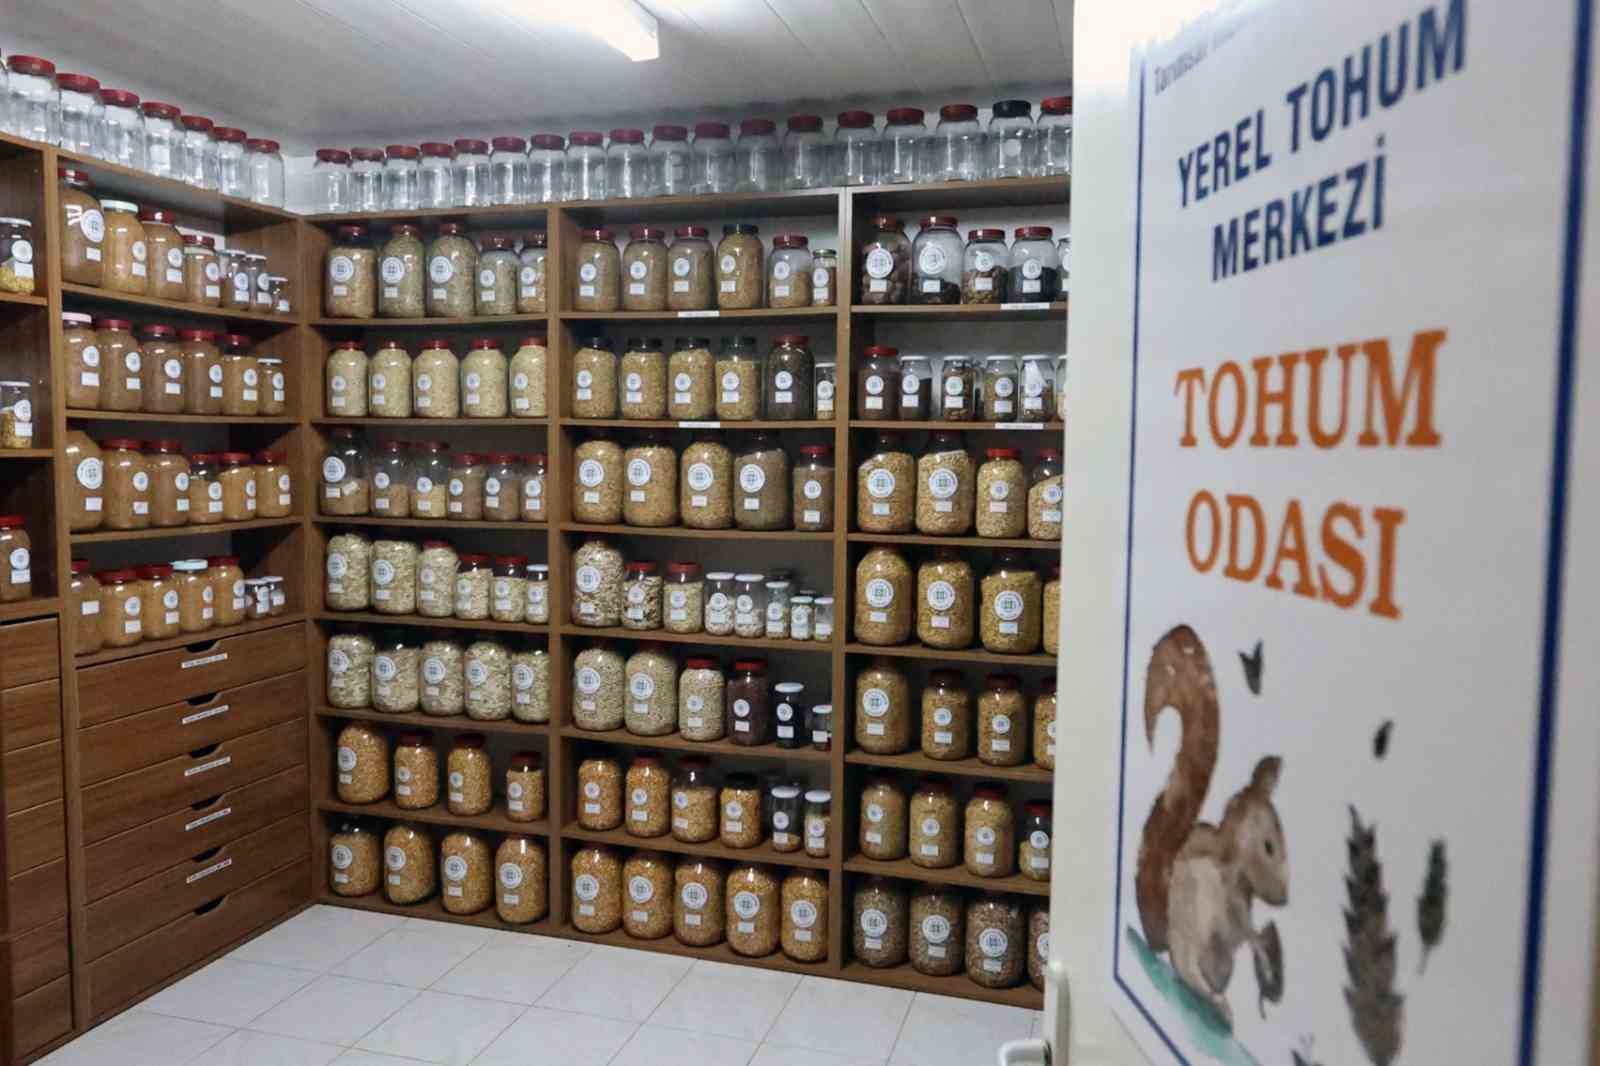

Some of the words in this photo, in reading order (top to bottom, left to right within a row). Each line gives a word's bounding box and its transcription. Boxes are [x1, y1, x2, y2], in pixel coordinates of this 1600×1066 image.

[1179, 111, 1272, 208] YEREL
[1286, 0, 1467, 154] TOHUM
[1212, 135, 1386, 281] MERKEZİ
[1175, 329, 1447, 449] TOHUM
[1186, 489, 1408, 620] ODASI
